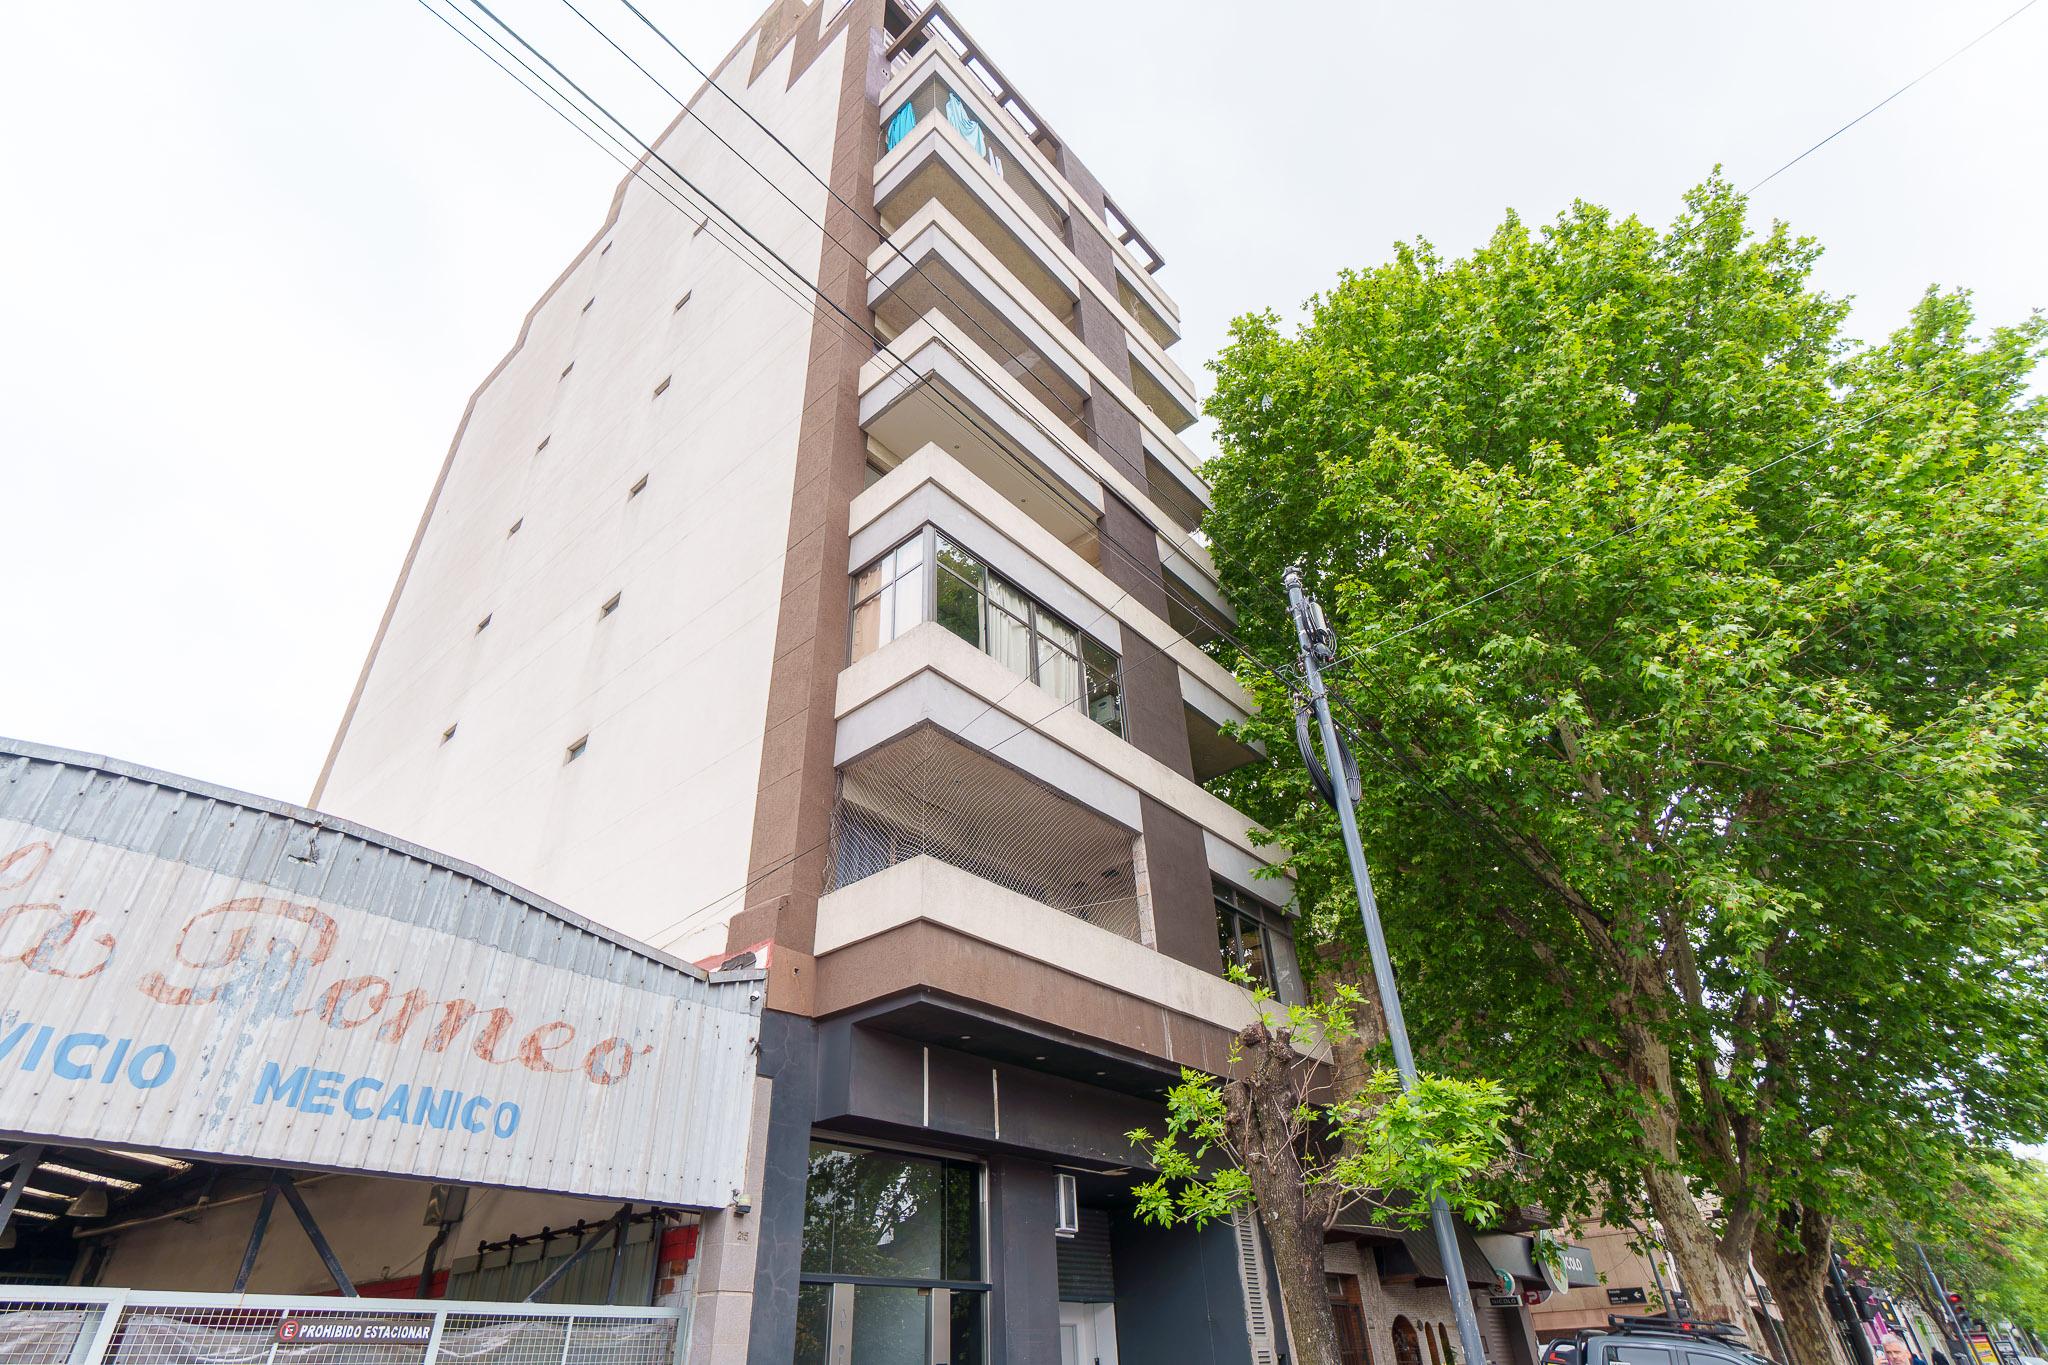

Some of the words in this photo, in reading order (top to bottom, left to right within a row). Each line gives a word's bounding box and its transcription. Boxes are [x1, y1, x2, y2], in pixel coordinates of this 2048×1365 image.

[138, 897, 654, 1087] Romeo
[252, 1061, 522, 1139] MECANICO
[299, 1324, 362, 1339] PROHIBIDO
[363, 1325, 431, 1339] ESTACIONAR
